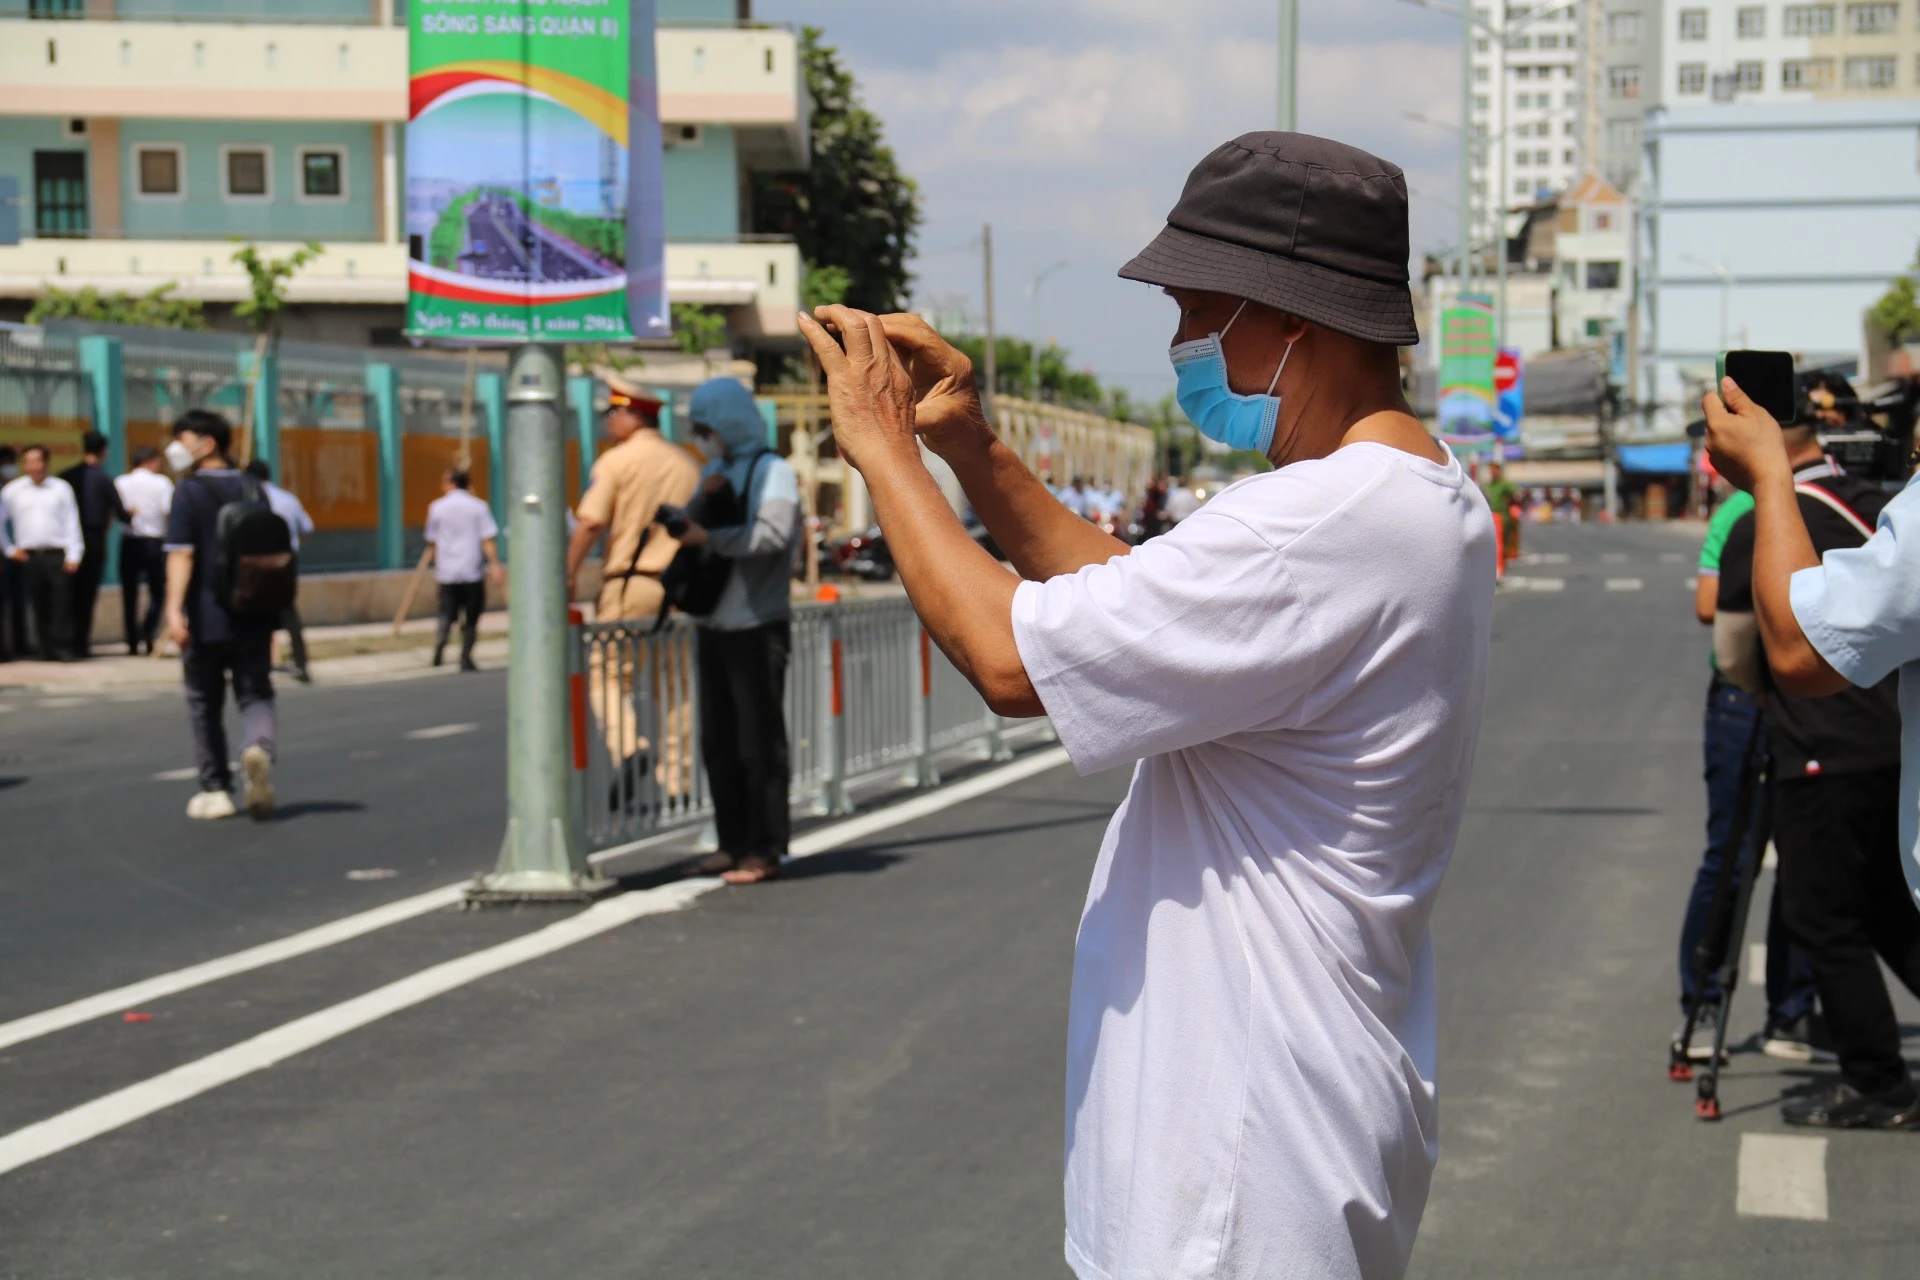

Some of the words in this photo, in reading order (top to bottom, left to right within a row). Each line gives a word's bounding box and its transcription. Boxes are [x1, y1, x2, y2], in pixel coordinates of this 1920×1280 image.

[539, 14, 596, 40] QUẬN
[415, 311, 452, 333] Ngày
[483, 311, 528, 333] tháng
[545, 317, 580, 331] năm
